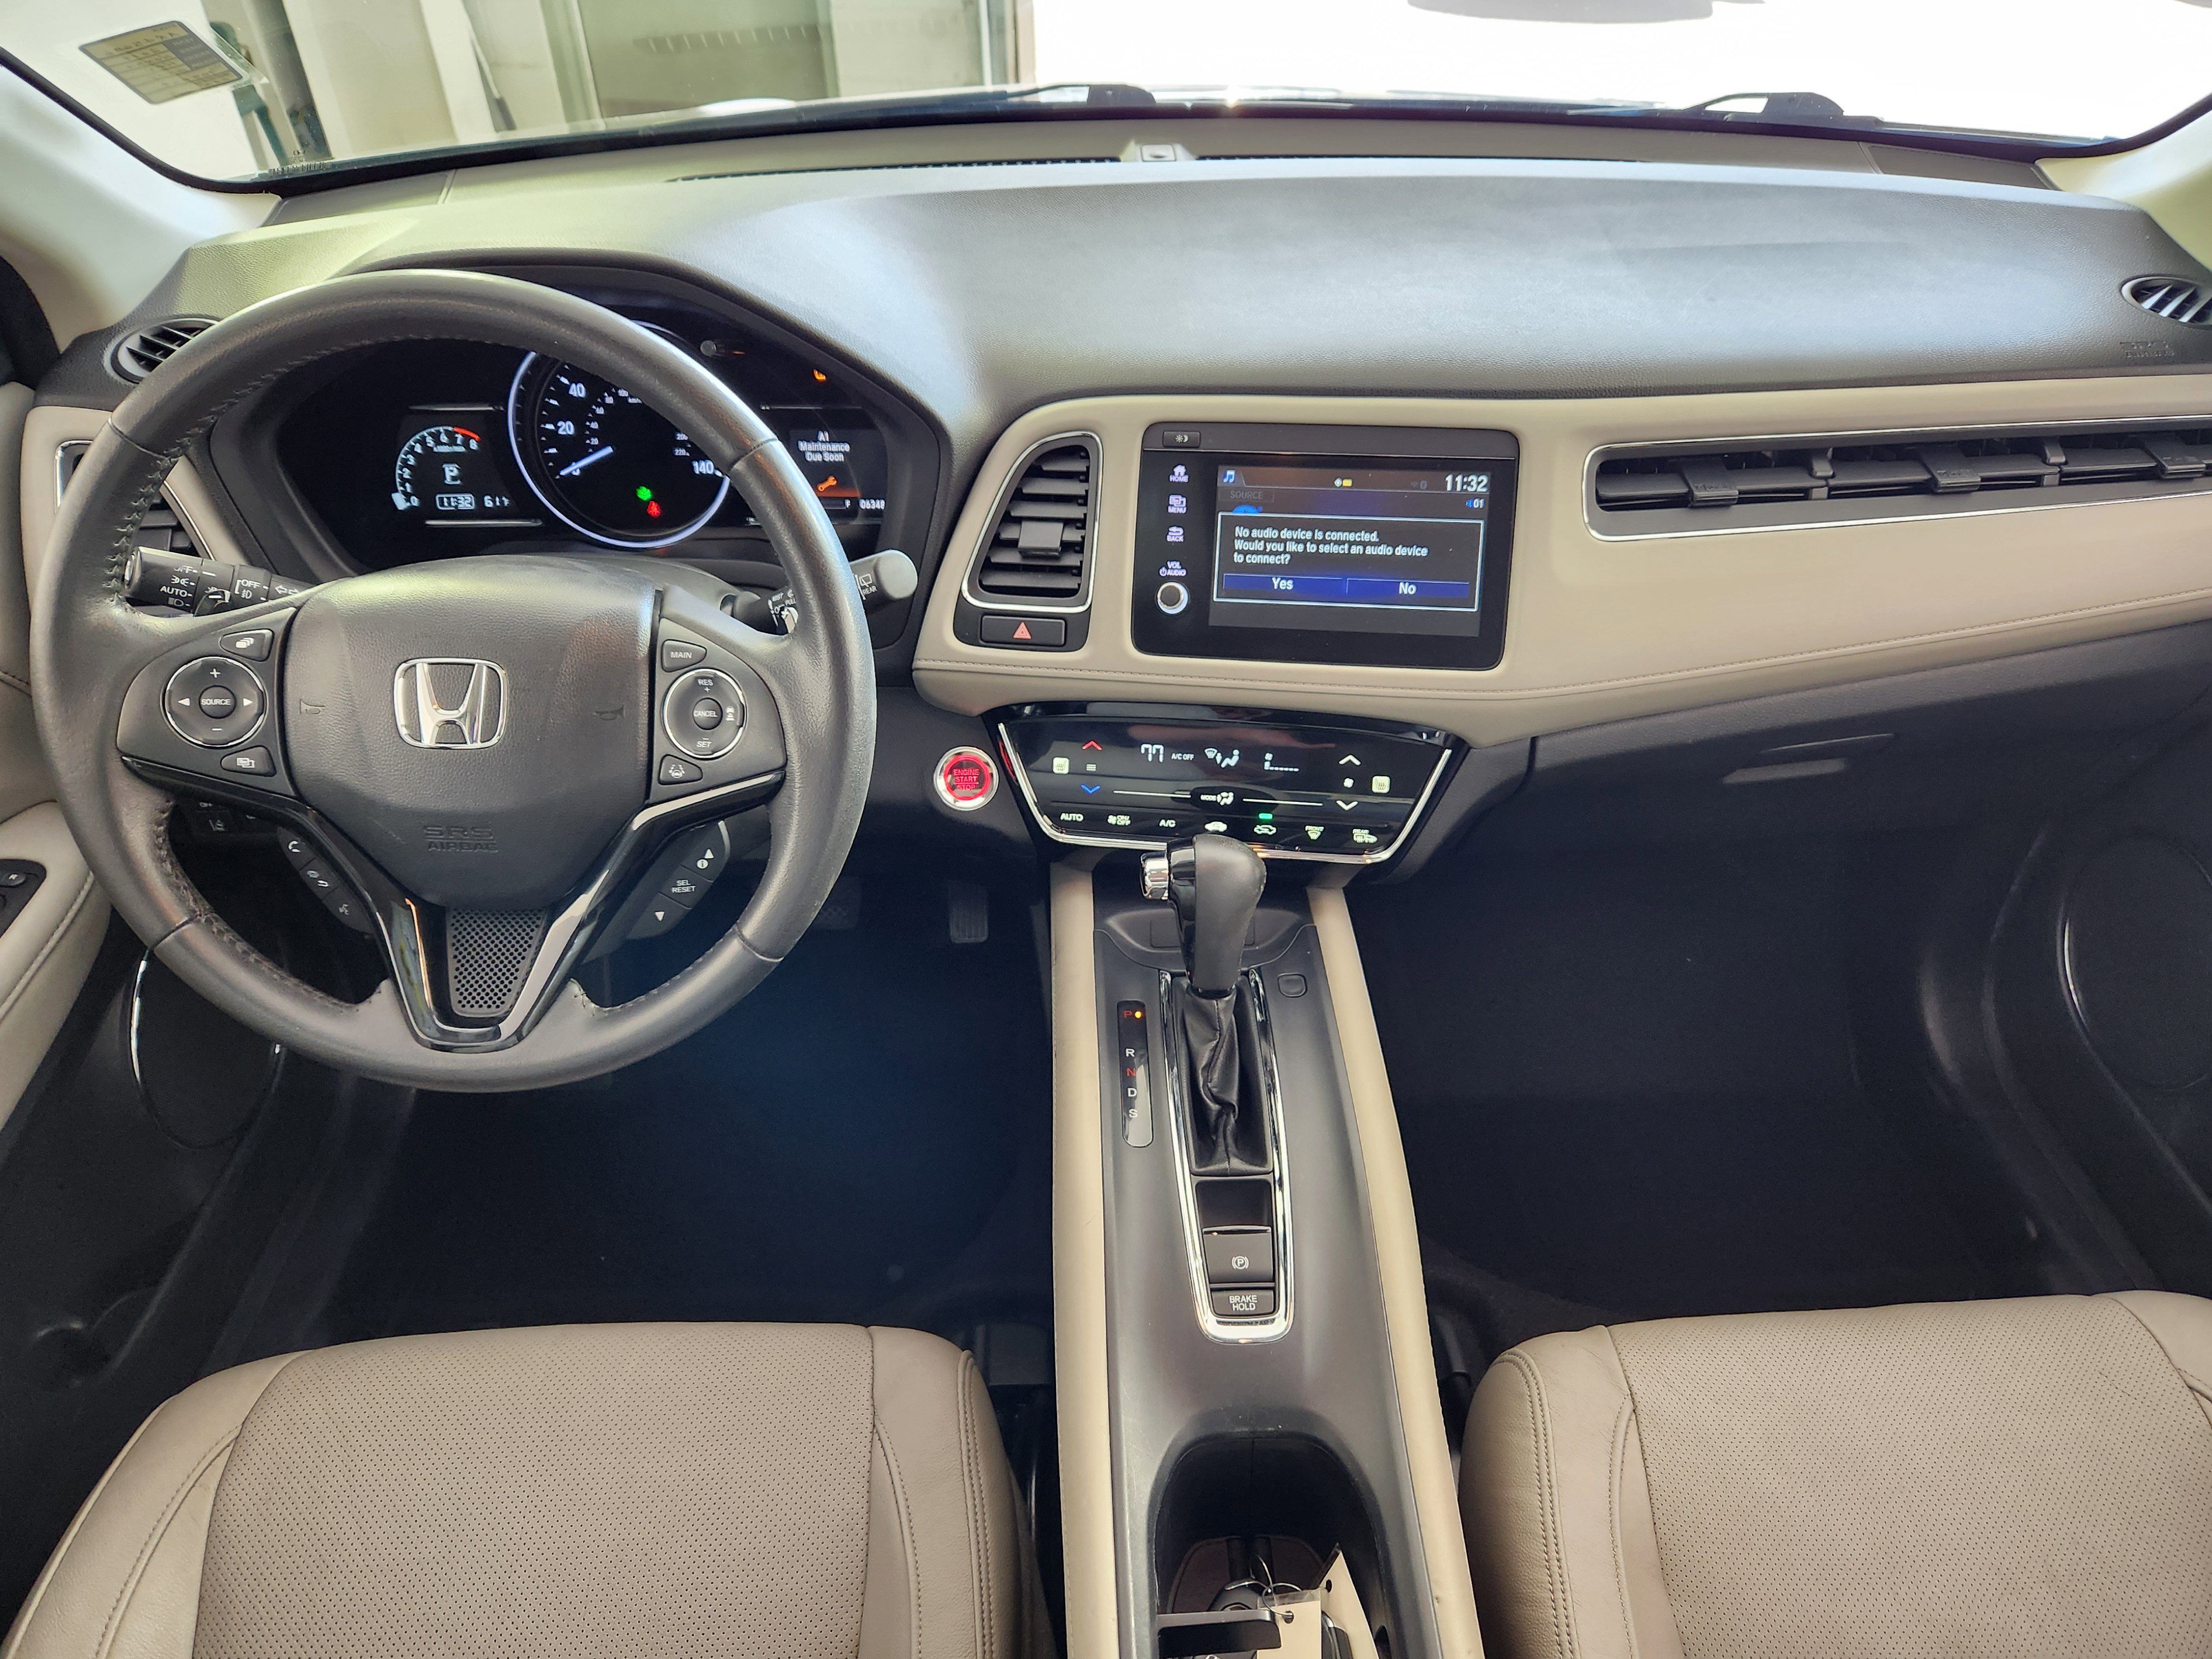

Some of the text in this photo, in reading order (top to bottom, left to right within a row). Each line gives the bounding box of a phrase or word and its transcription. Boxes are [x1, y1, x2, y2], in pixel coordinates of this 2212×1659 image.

[568, 383, 586, 398] 40
[557, 421, 575, 435] 20
[818, 431, 829, 442] A1
[798, 441, 851, 452] Maintenance
[805, 452, 844, 462] Due Soon
[692, 460, 714, 474] 140
[1446, 474, 1488, 492] 11:32
[1230, 490, 1263, 499] SOURCE
[845, 499, 851, 508] F
[1473, 498, 1485, 508] 01
[1235, 526, 1380, 542] No audio device is connected.
[1234, 539, 1429, 556] Would you like to select an audio device
[1233, 552, 1292, 565] to connect?
[1167, 561, 1181, 569] VOL
[241, 579, 261, 589] OFF
[1272, 577, 1294, 589] Yes
[1399, 582, 1417, 594] No
[160, 586, 188, 597] AUTO
[863, 586, 878, 596] REAR
[1141, 744, 1164, 763] 77
[1060, 813, 1084, 821] AUTO
[1159, 819, 1176, 827] A/C
[1125, 1048, 1135, 1057] R
[1126, 1068, 1136, 1076] N
[1128, 1088, 1137, 1097] D
[1129, 1108, 1138, 1118] S
[1229, 1295, 1258, 1303] BRAKE
[1233, 1303, 1256, 1311] HOLD
